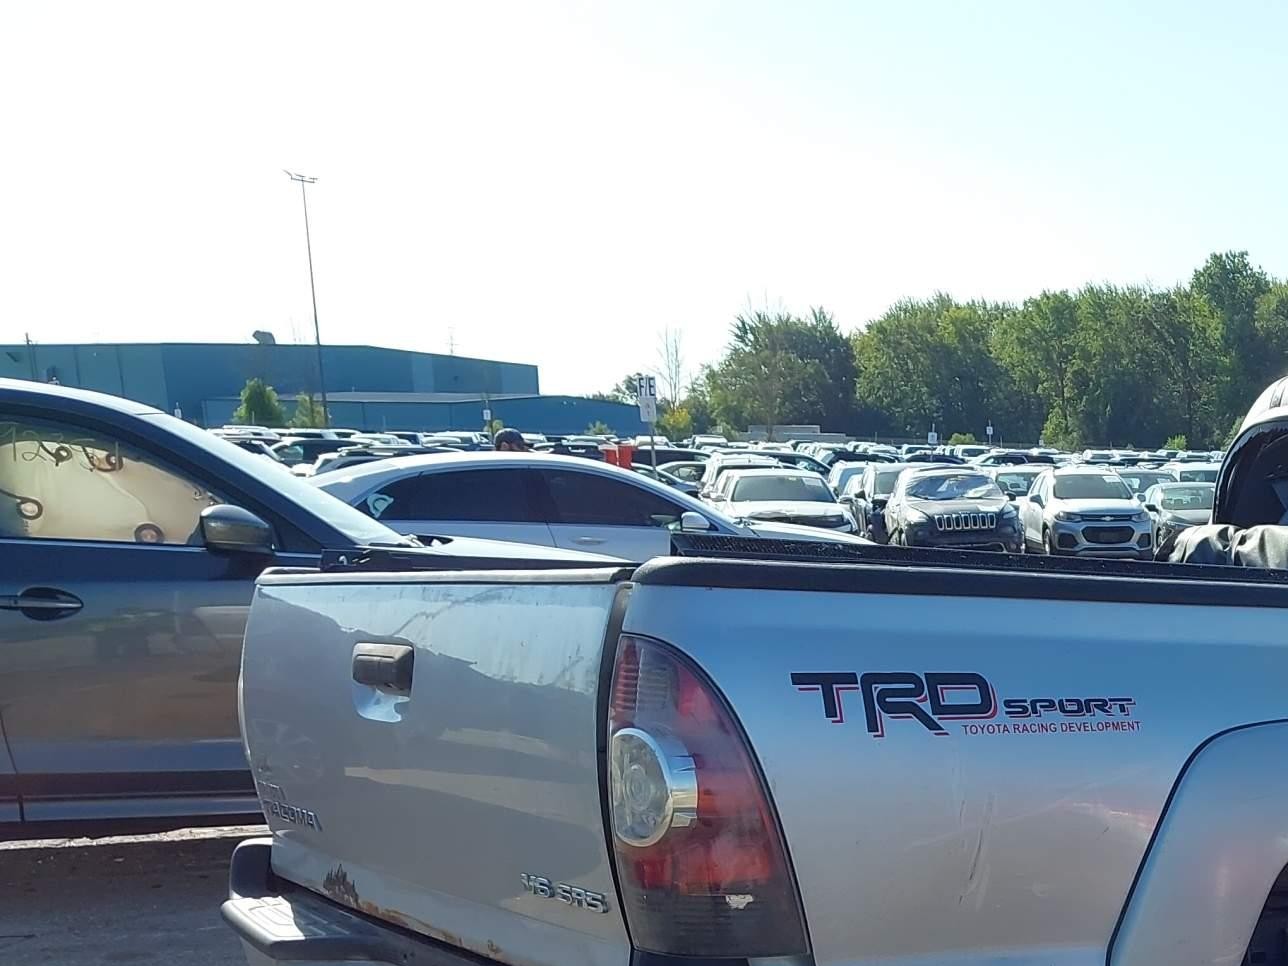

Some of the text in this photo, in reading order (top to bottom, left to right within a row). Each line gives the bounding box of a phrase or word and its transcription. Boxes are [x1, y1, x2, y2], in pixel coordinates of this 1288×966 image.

[638, 377, 656, 397] F/E
[790, 671, 1136, 738] TRD SPORT
[962, 720, 1142, 736] TOYOTA RACING DEVELOPMENT
[520, 872, 555, 898] V6
